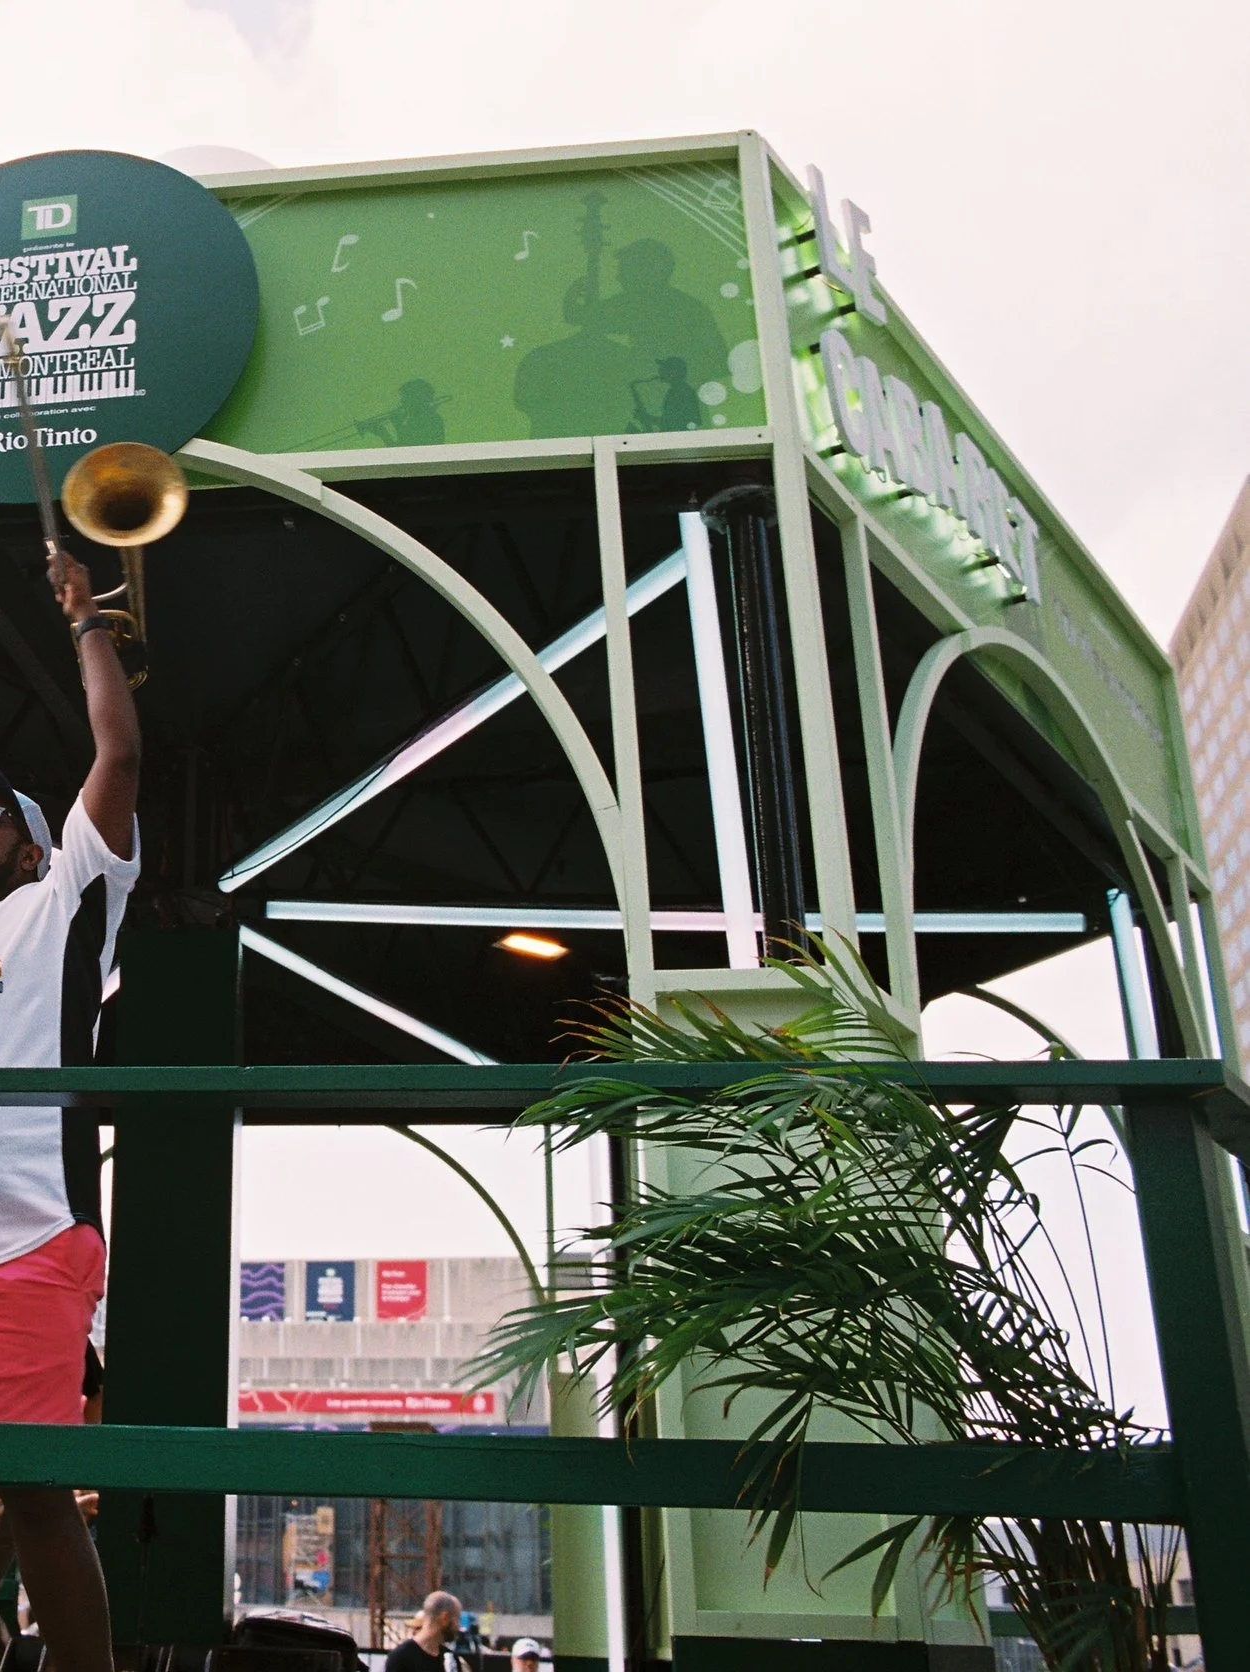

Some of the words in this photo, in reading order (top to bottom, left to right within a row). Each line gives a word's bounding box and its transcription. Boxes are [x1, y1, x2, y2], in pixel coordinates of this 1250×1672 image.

[28, 203, 71, 231] TD
[806, 163, 888, 327] LE
[70, 405, 96, 414] avec
[34, 428, 97, 448] Tinto
[819, 328, 1041, 607] CABARET
